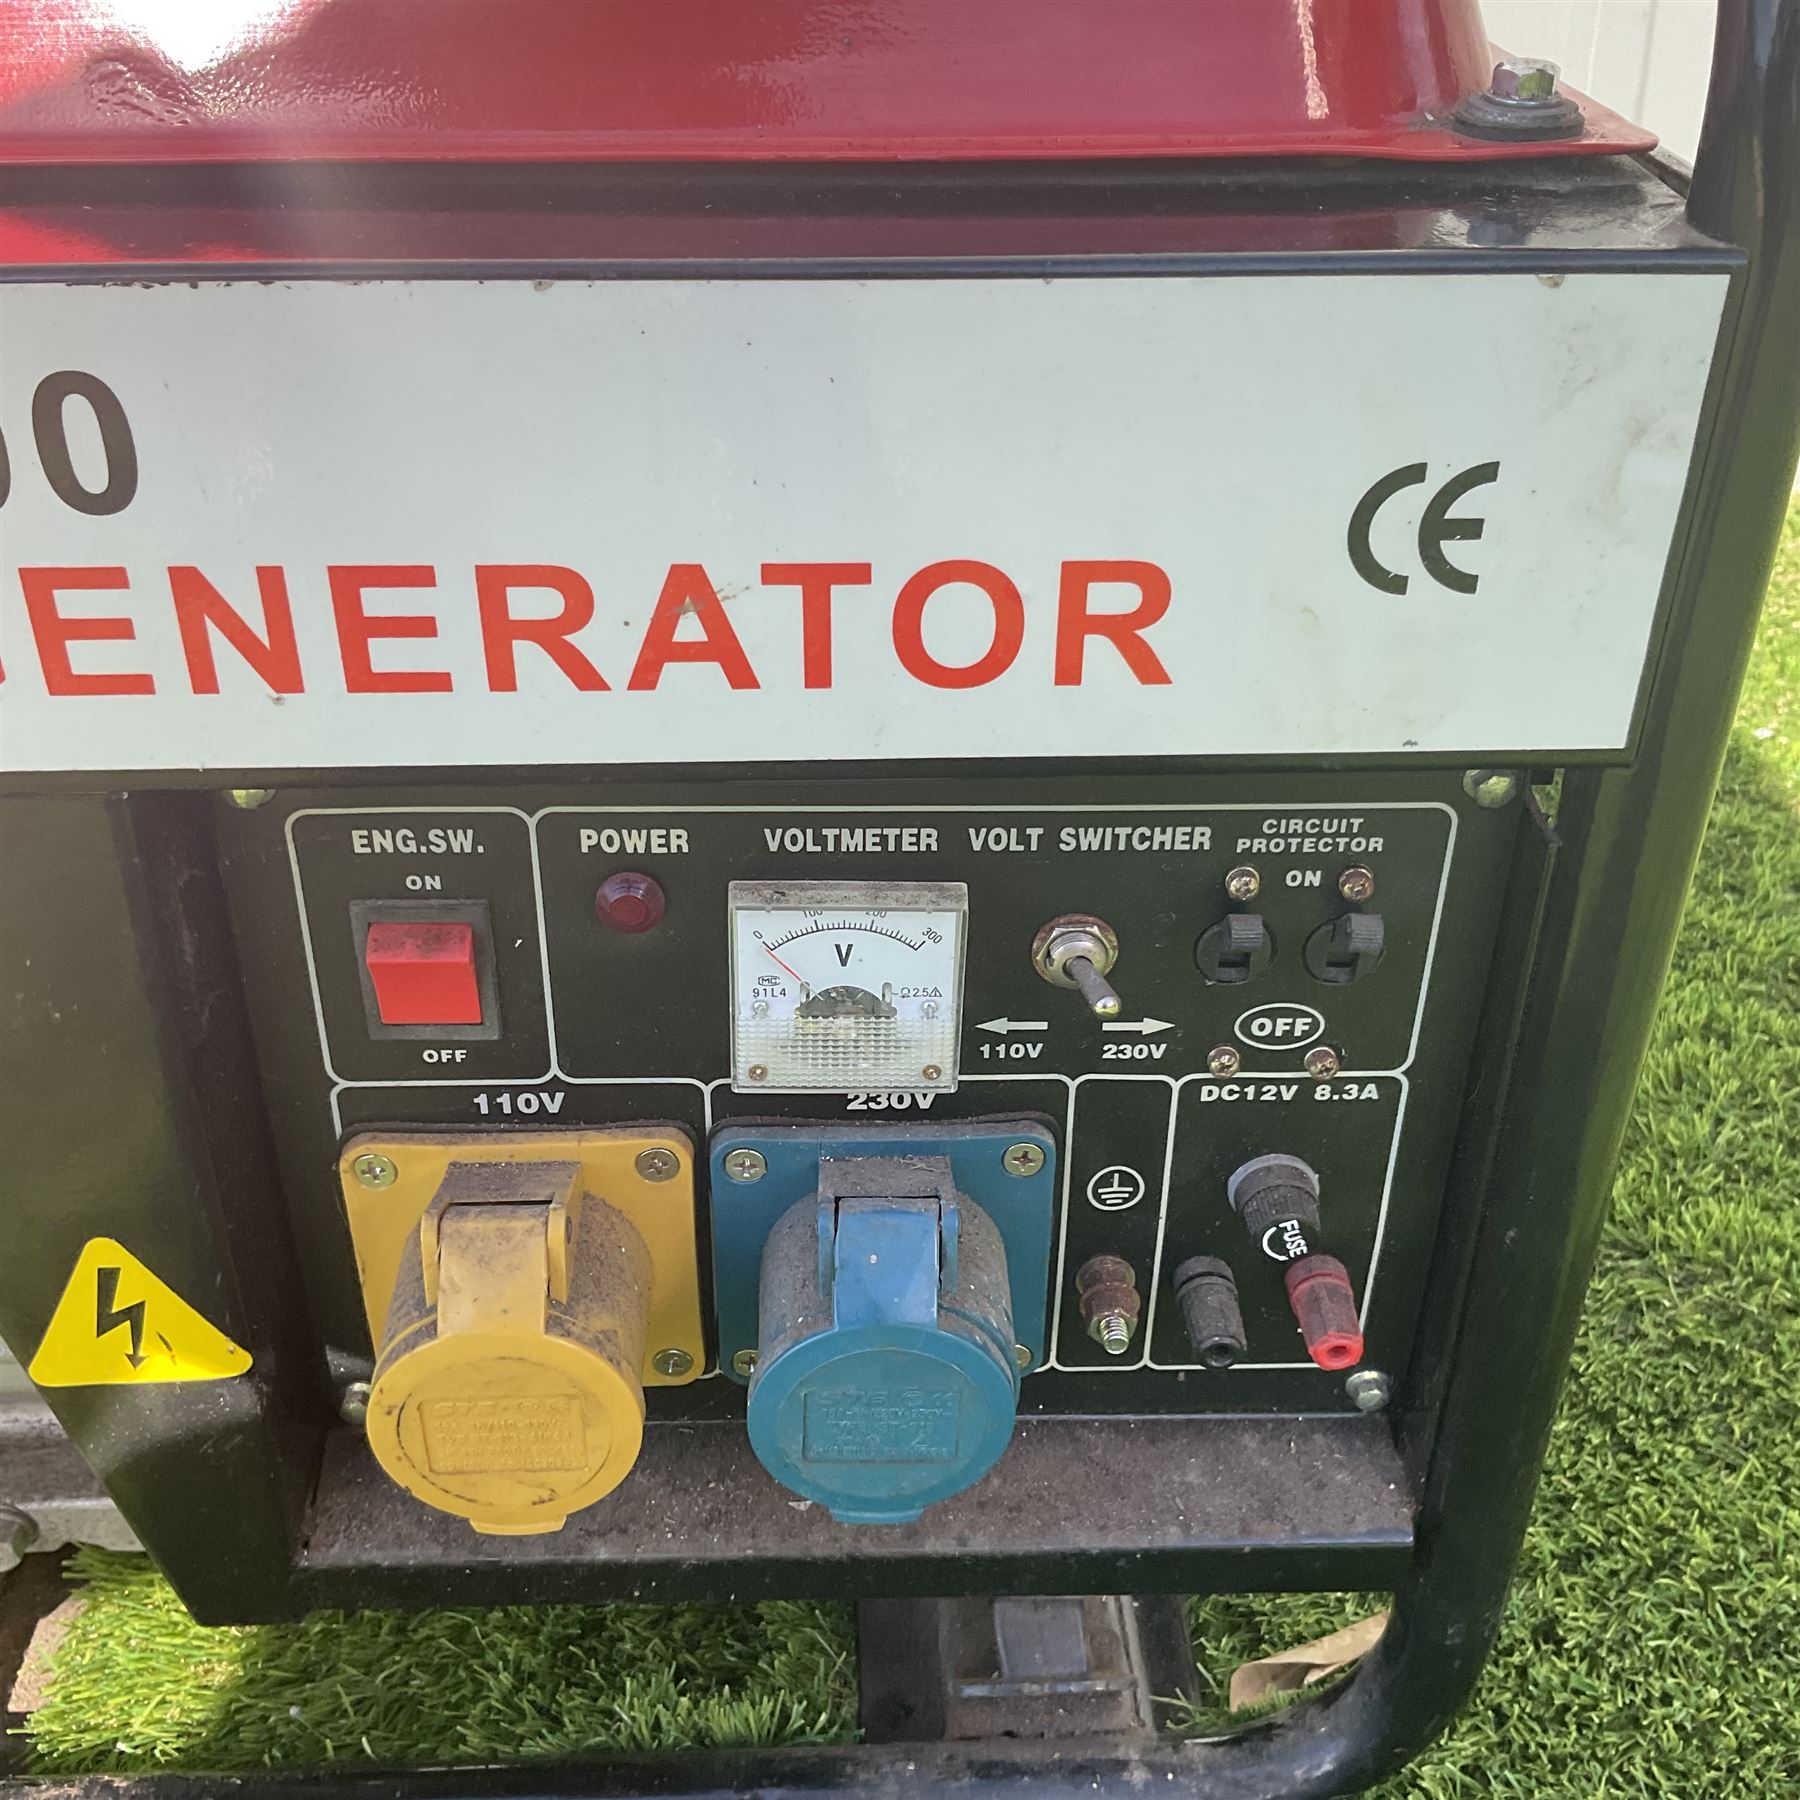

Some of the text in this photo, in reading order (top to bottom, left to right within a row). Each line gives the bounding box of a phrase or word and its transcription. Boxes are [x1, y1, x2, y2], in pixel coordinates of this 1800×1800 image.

[0, 370, 139, 517] 0
[1347, 461, 1501, 596] CE
[0, 559, 1173, 695] ENERATOR
[1262, 818, 1365, 834] CIRCUIT
[351, 828, 485, 854] ENG.SW.
[579, 828, 692, 854] POWER
[763, 827, 939, 853] VOLTMETER
[968, 826, 1212, 852] VOLT SWITCHER
[1236, 836, 1384, 854] PROTECTOR
[405, 875, 442, 891] ON
[1285, 870, 1322, 887] ON
[752, 930, 763, 940] 0
[922, 927, 943, 944] 300
[834, 943, 854, 968] V
[752, 987, 787, 998] 91L4
[1250, 1017, 1313, 1037] OFF
[422, 1049, 467, 1063] OFF
[979, 1042, 1044, 1059] 110V
[1101, 1043, 1168, 1060] 230V
[846, 1092, 937, 1110] 230V
[1200, 1083, 1380, 1102] DC12V 8.3A
[473, 1091, 565, 1115] 110V
[1278, 1219, 1308, 1258] FUSE
